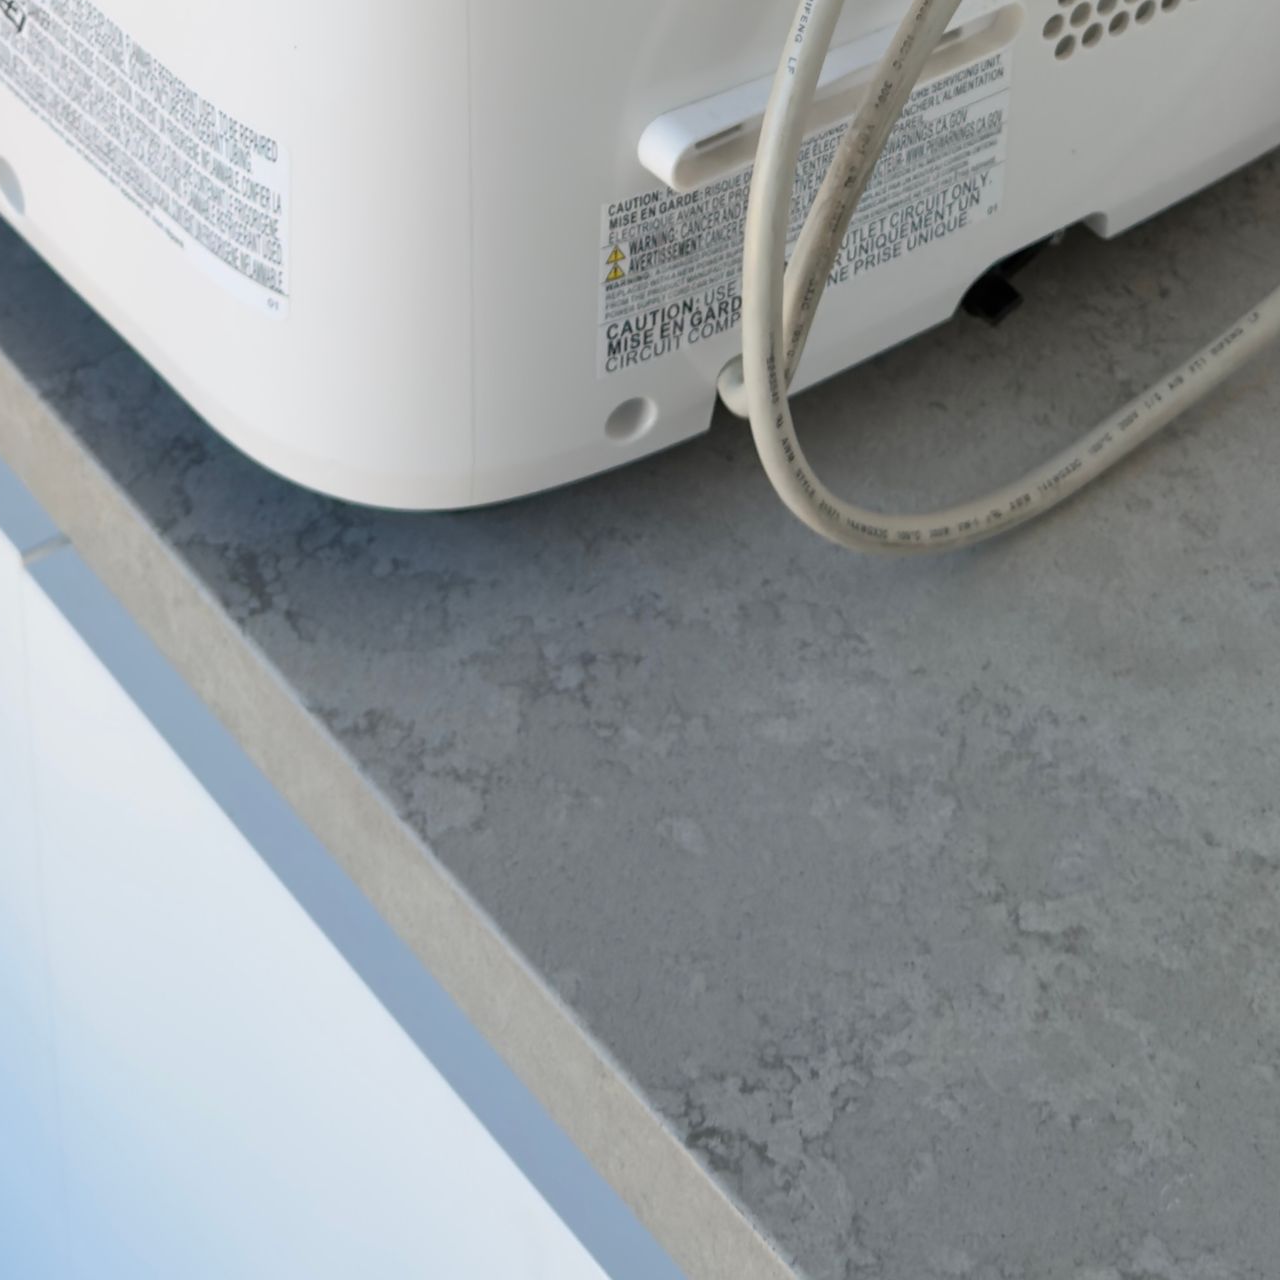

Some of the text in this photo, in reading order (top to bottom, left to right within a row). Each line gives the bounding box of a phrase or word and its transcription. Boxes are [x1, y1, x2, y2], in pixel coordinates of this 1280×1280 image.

[784, 56, 798, 75] LF
[608, 188, 661, 217] CAUTION:
[931, 64, 977, 93] SERVICING
[608, 211, 635, 231] MISE
[640, 204, 655, 220] EN
[659, 189, 703, 213] GARDE:
[704, 175, 740, 197] RISQUE
[608, 193, 725, 244] ÉLECTRIQUE AVANT DE
[606, 294, 700, 340] CAUTION:
[703, 281, 736, 305] USE
[840, 214, 886, 250] UTLET
[889, 189, 948, 228] CIRCUIT
[951, 170, 993, 200] ONLY.
[629, 203, 741, 256] WARNING: CANCER AND
[701, 244, 728, 257] POWER
[706, 221, 738, 245] CANCER
[605, 282, 647, 301] REPLACED
[649, 274, 668, 286] WITH
[677, 265, 694, 276] NEW
[696, 255, 723, 269] POWER
[605, 278, 684, 311] FROM THE PRODUCT
[605, 304, 634, 320] POWER
[636, 293, 665, 308] SUPPLY
[668, 285, 689, 297] CORD
[690, 278, 707, 289] CAN
[709, 272, 724, 283] NOT
[607, 328, 653, 357] MISE
[660, 316, 684, 338] EN
[690, 296, 742, 326] GARD
[846, 202, 953, 262] UNIQUEMENT
[958, 190, 980, 211] UN
[604, 333, 683, 373] CIRCUIT
[687, 312, 740, 342] COMP
[826, 265, 849, 287] NE
[854, 241, 902, 274] PRISE
